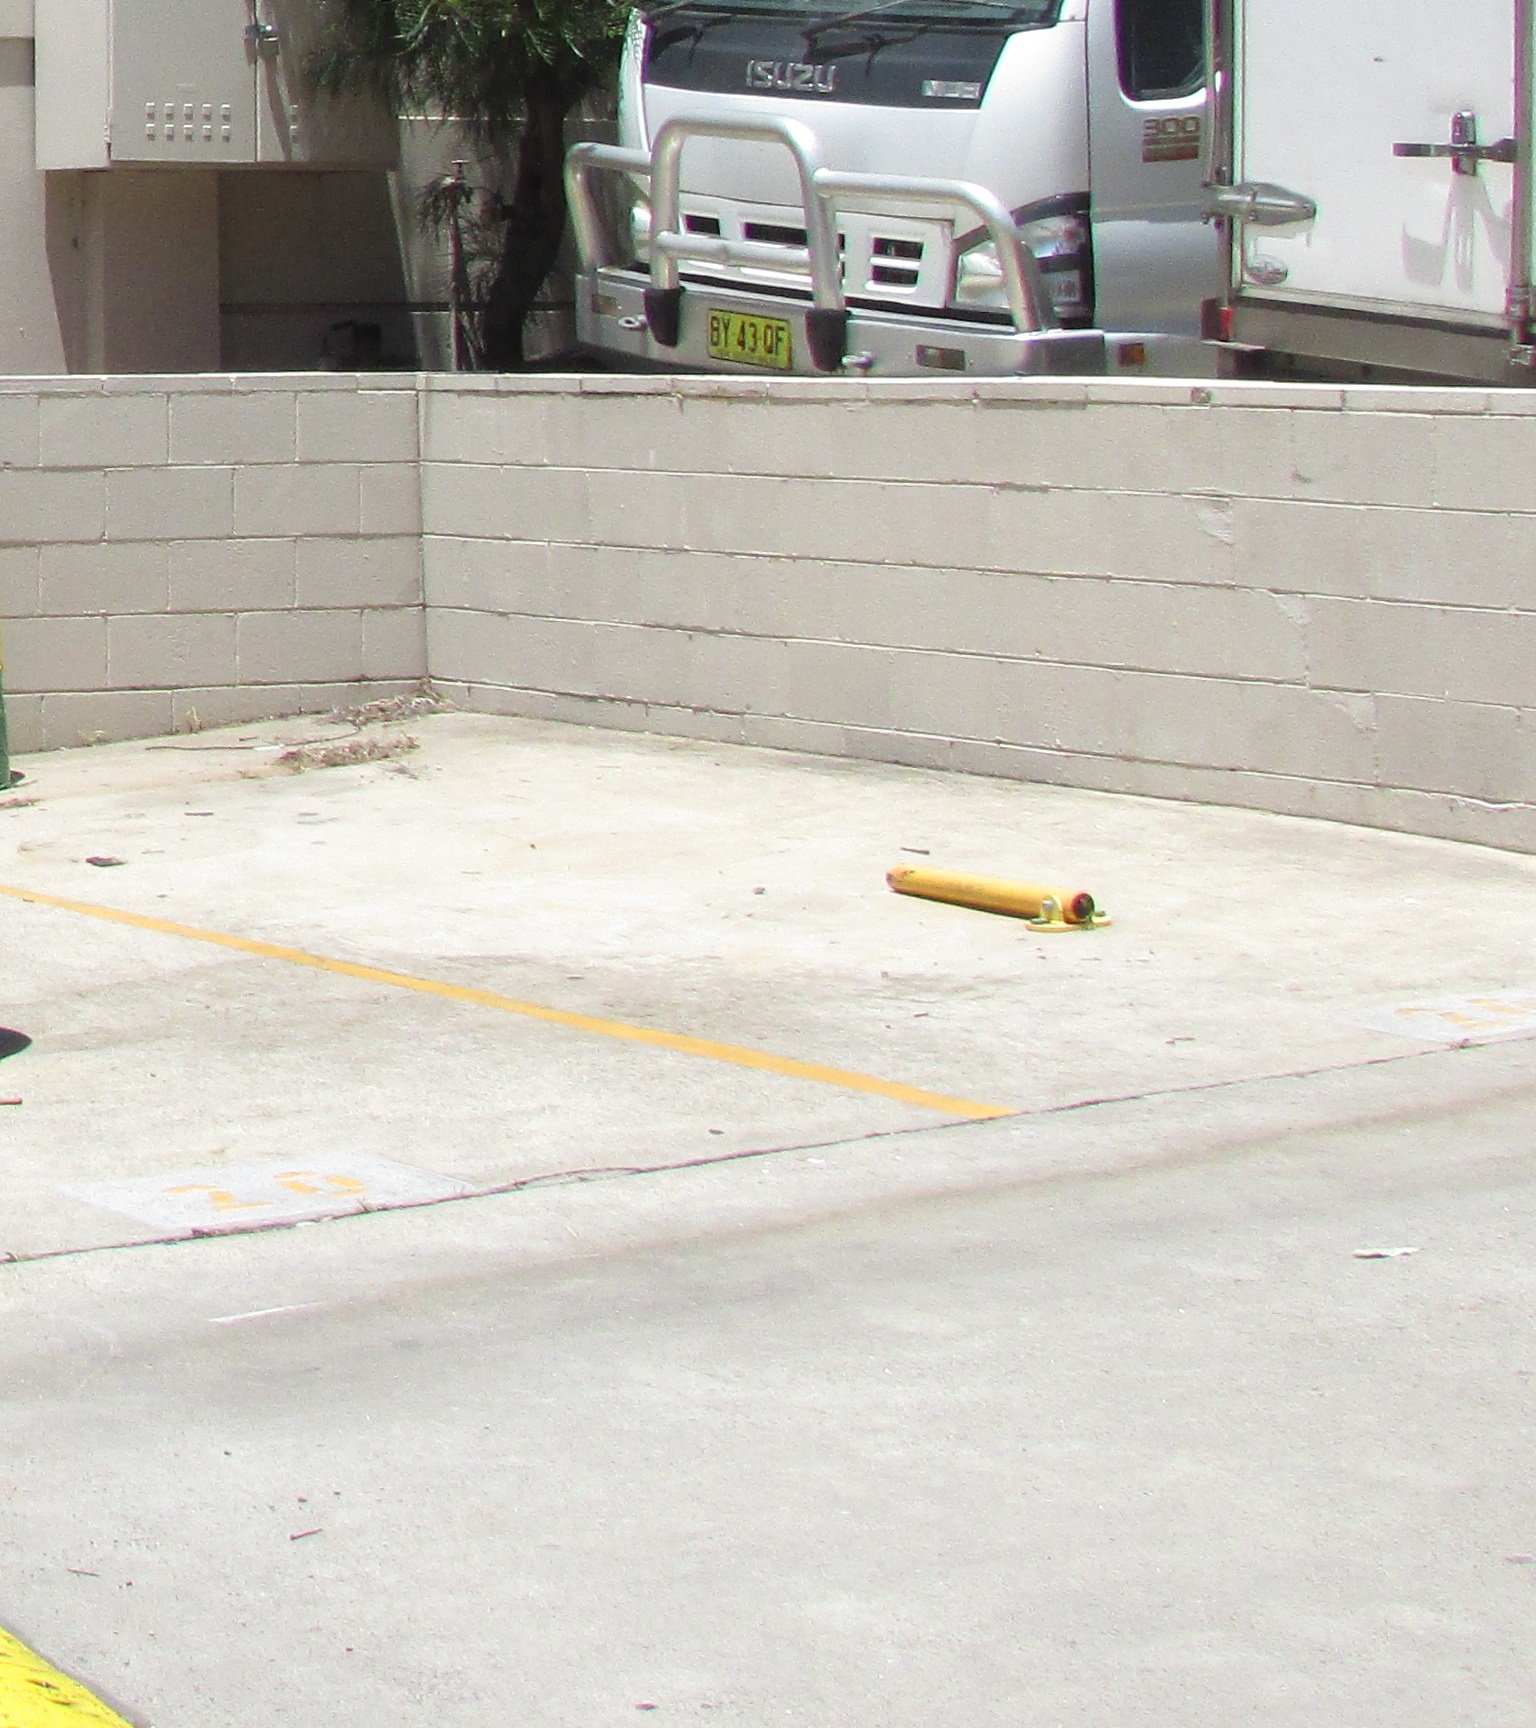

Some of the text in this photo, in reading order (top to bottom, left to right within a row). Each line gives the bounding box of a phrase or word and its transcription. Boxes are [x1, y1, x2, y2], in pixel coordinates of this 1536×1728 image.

[746, 59, 837, 93] ISUZU
[1143, 115, 1201, 137] 300
[163, 1170, 368, 1213] 20
